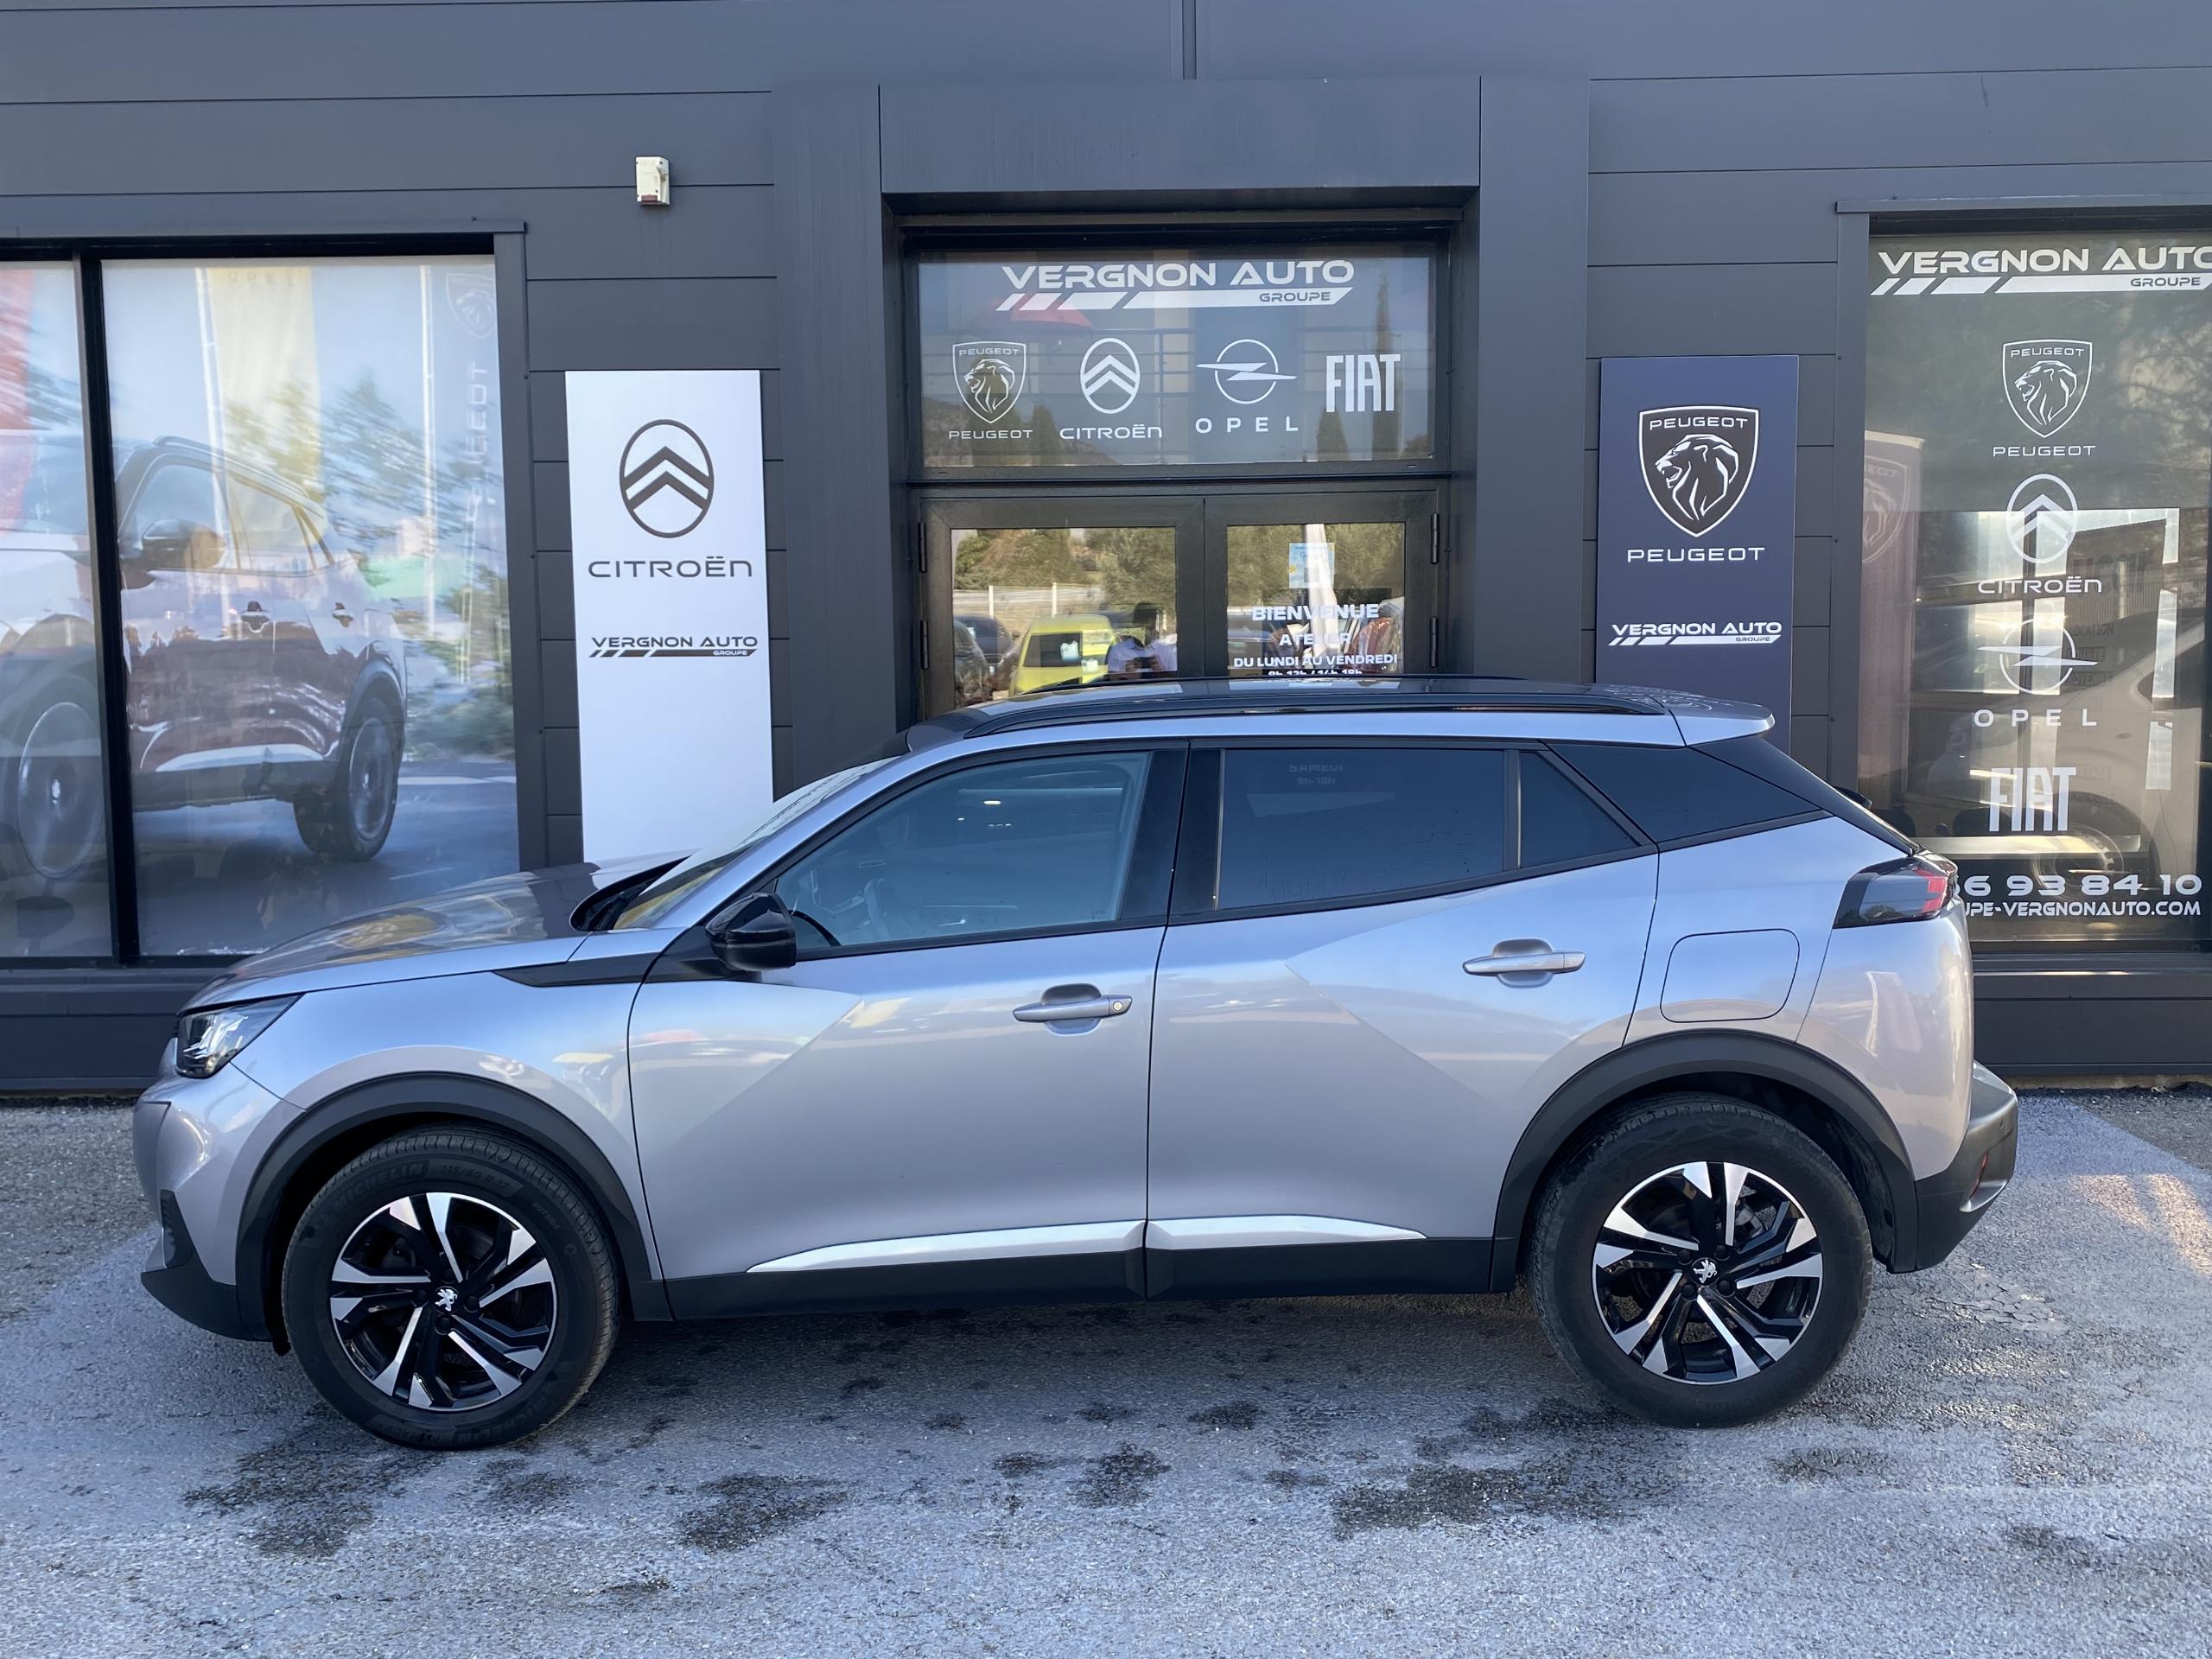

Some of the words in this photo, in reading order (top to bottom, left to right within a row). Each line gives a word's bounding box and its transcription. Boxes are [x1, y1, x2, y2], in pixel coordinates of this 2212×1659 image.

[1878, 248, 2089, 275] VERGNON
[2101, 245, 2212, 271] AUTO
[1001, 263, 1217, 290] VERGNON
[1228, 259, 1356, 286] AUTO
[2130, 276, 2202, 288] GROUPE
[1259, 290, 1332, 303] GROUPE
[959, 347, 1020, 357] PEUGEOT
[2010, 346, 2085, 358] PEUGEOT
[1325, 354, 1402, 413] FIAT
[1649, 416, 1749, 430] PEUGEOT
[949, 429, 1033, 440] PEUGEOT
[1059, 424, 1162, 440] CITROËN
[1993, 444, 2096, 457] PEUGEOT
[1627, 547, 1765, 563] PEUGEOT
[588, 556, 753, 578] CITROËN
[1978, 575, 2102, 594] CITROËN
[1611, 623, 1716, 636] VERGNON
[1721, 621, 1783, 635] AUTO
[591, 636, 693, 648] VERGNON
[699, 635, 759, 647] AUTO
[1233, 657, 1254, 667] DU
[1257, 655, 1300, 667] LUNDI
[1301, 655, 1323, 665] AU
[1326, 653, 1397, 664] VENDREDI
[1989, 766, 2076, 832] FIAT
[1955, 875, 1992, 897] 6
[2007, 874, 2066, 896] 93
[2081, 874, 2143, 896] 84
[2160, 873, 2202, 895] 10
